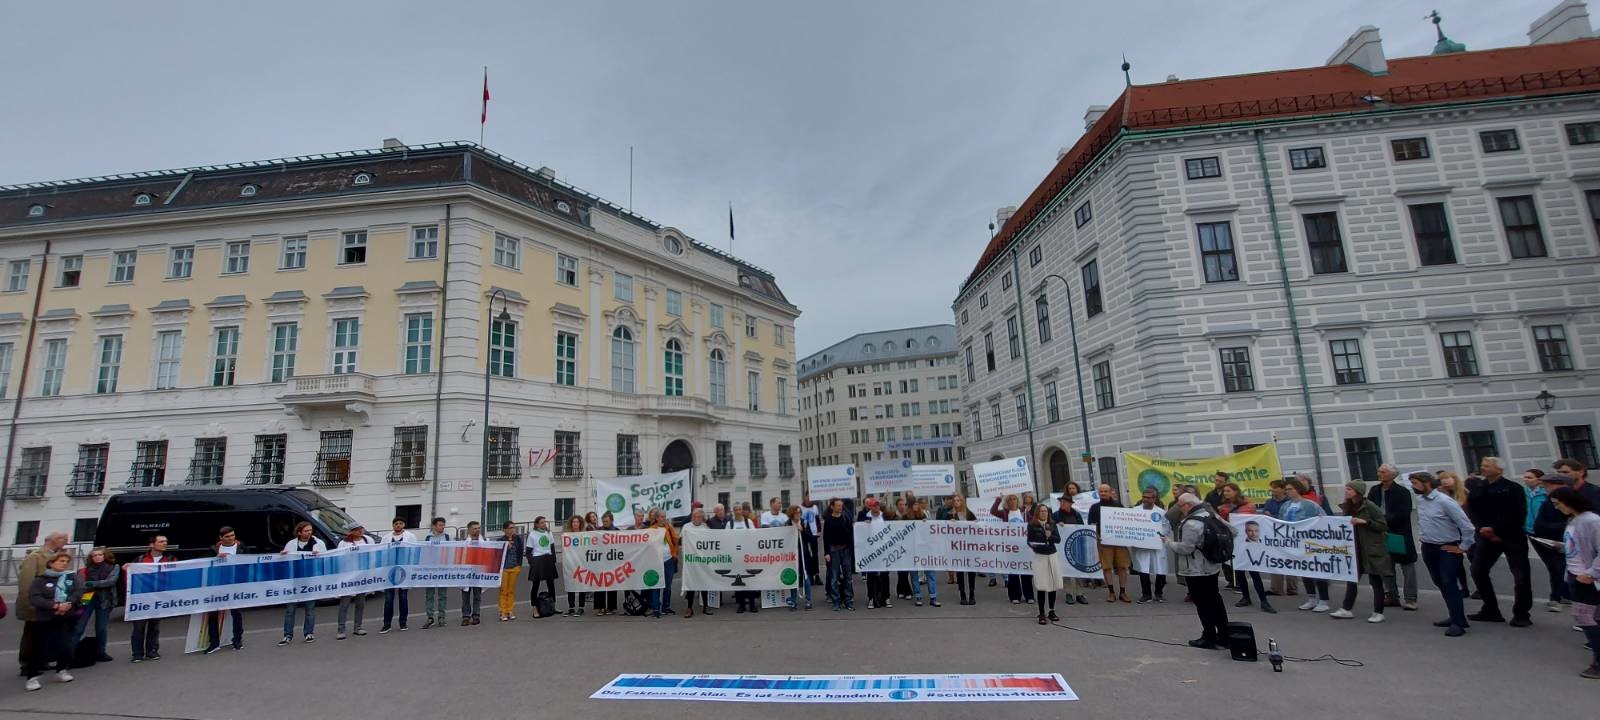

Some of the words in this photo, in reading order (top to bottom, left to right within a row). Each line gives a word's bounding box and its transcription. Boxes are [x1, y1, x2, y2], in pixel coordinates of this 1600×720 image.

[1173, 466, 1270, 484] Demoratie
[630, 480, 684, 498] Seniors
[632, 498, 682, 516] Fuure
[649, 492, 669, 506] for
[867, 524, 892, 546] Super
[930, 524, 1028, 537] Sicherheitsrisik
[1273, 523, 1353, 541] Klimaschutz
[564, 536, 598, 548] Deine
[602, 532, 650, 545] Stimme
[696, 540, 720, 550] GUTE
[758, 539, 784, 550] GUTE
[857, 521, 916, 570] Klimawahljahr
[952, 541, 1020, 553] Klimakrise
[1264, 536, 1300, 548] braucht
[586, 550, 603, 562] für
[606, 549, 624, 561] die
[684, 554, 732, 564] Klimapolitik
[744, 552, 796, 564] Sozialpolitik
[882, 546, 906, 568] 2024
[914, 556, 948, 567] Politik
[952, 557, 970, 568] mit
[974, 557, 1033, 570] Sachverst
[1246, 549, 1342, 574] Wissenschaft
[411, 572, 500, 582] #scientists4future
[573, 562, 636, 588] KINDER
[130, 603, 150, 612] Die
[154, 598, 199, 610] Fakten
[203, 594, 230, 604] sind
[233, 591, 259, 601] klar.
[266, 588, 279, 598] Es
[283, 587, 298, 596] ist
[300, 584, 322, 594] Zeit
[325, 582, 338, 592] zu
[341, 576, 386, 588] handeln.
